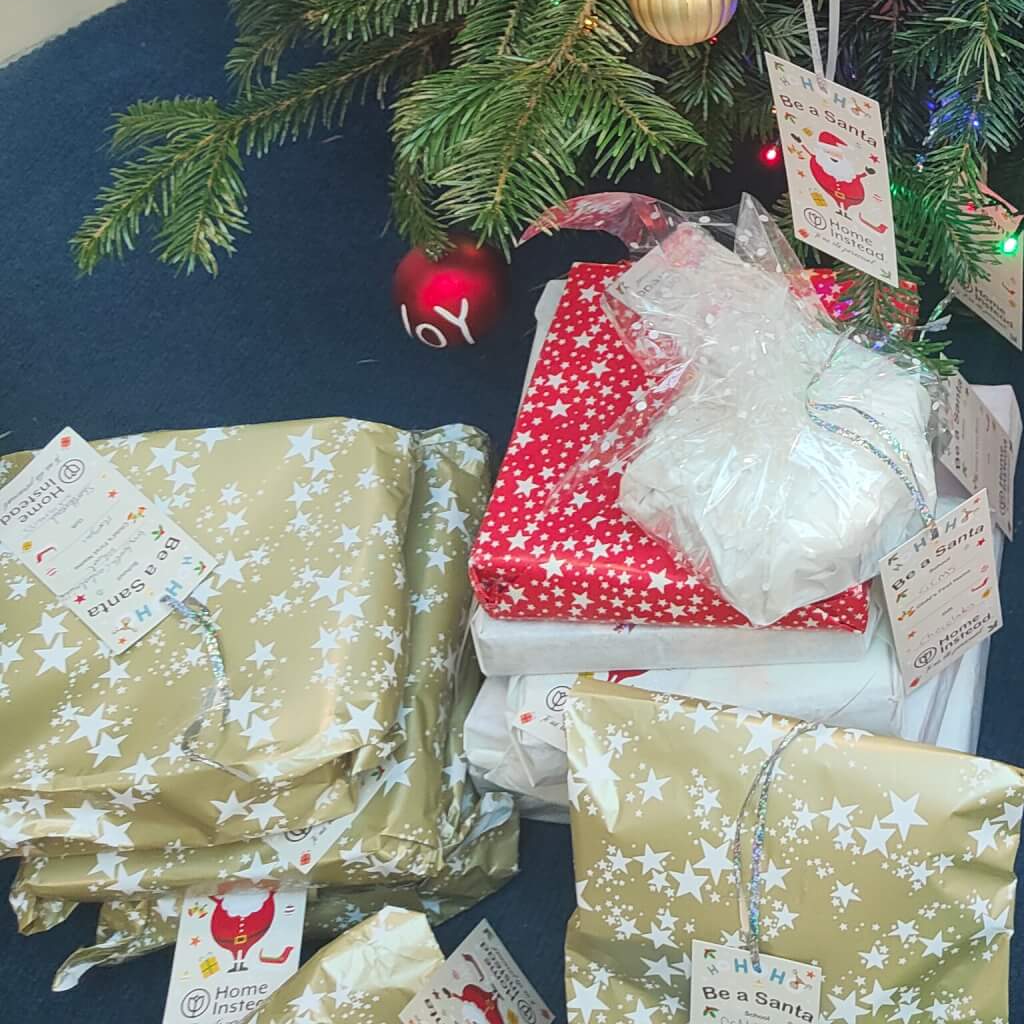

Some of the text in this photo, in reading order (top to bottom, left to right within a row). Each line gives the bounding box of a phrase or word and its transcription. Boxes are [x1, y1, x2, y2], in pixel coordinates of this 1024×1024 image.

[780, 94, 878, 148] Be a Santa
[829, 217, 873, 247] Home
[830, 229, 885, 261] Instead
[0, 478, 57, 527] Instead
[19, 485, 64, 524] Home
[87, 537, 180, 617] Be a Santa
[891, 525, 985, 592] Be a Santa
[938, 613, 982, 646] Home
[940, 612, 992, 653] Instead
[212, 999, 264, 1015] Inste
[215, 983, 268, 999] Home
[702, 986, 730, 1000] Be
[737, 991, 749, 1002] a
[755, 991, 814, 1023] Santa
